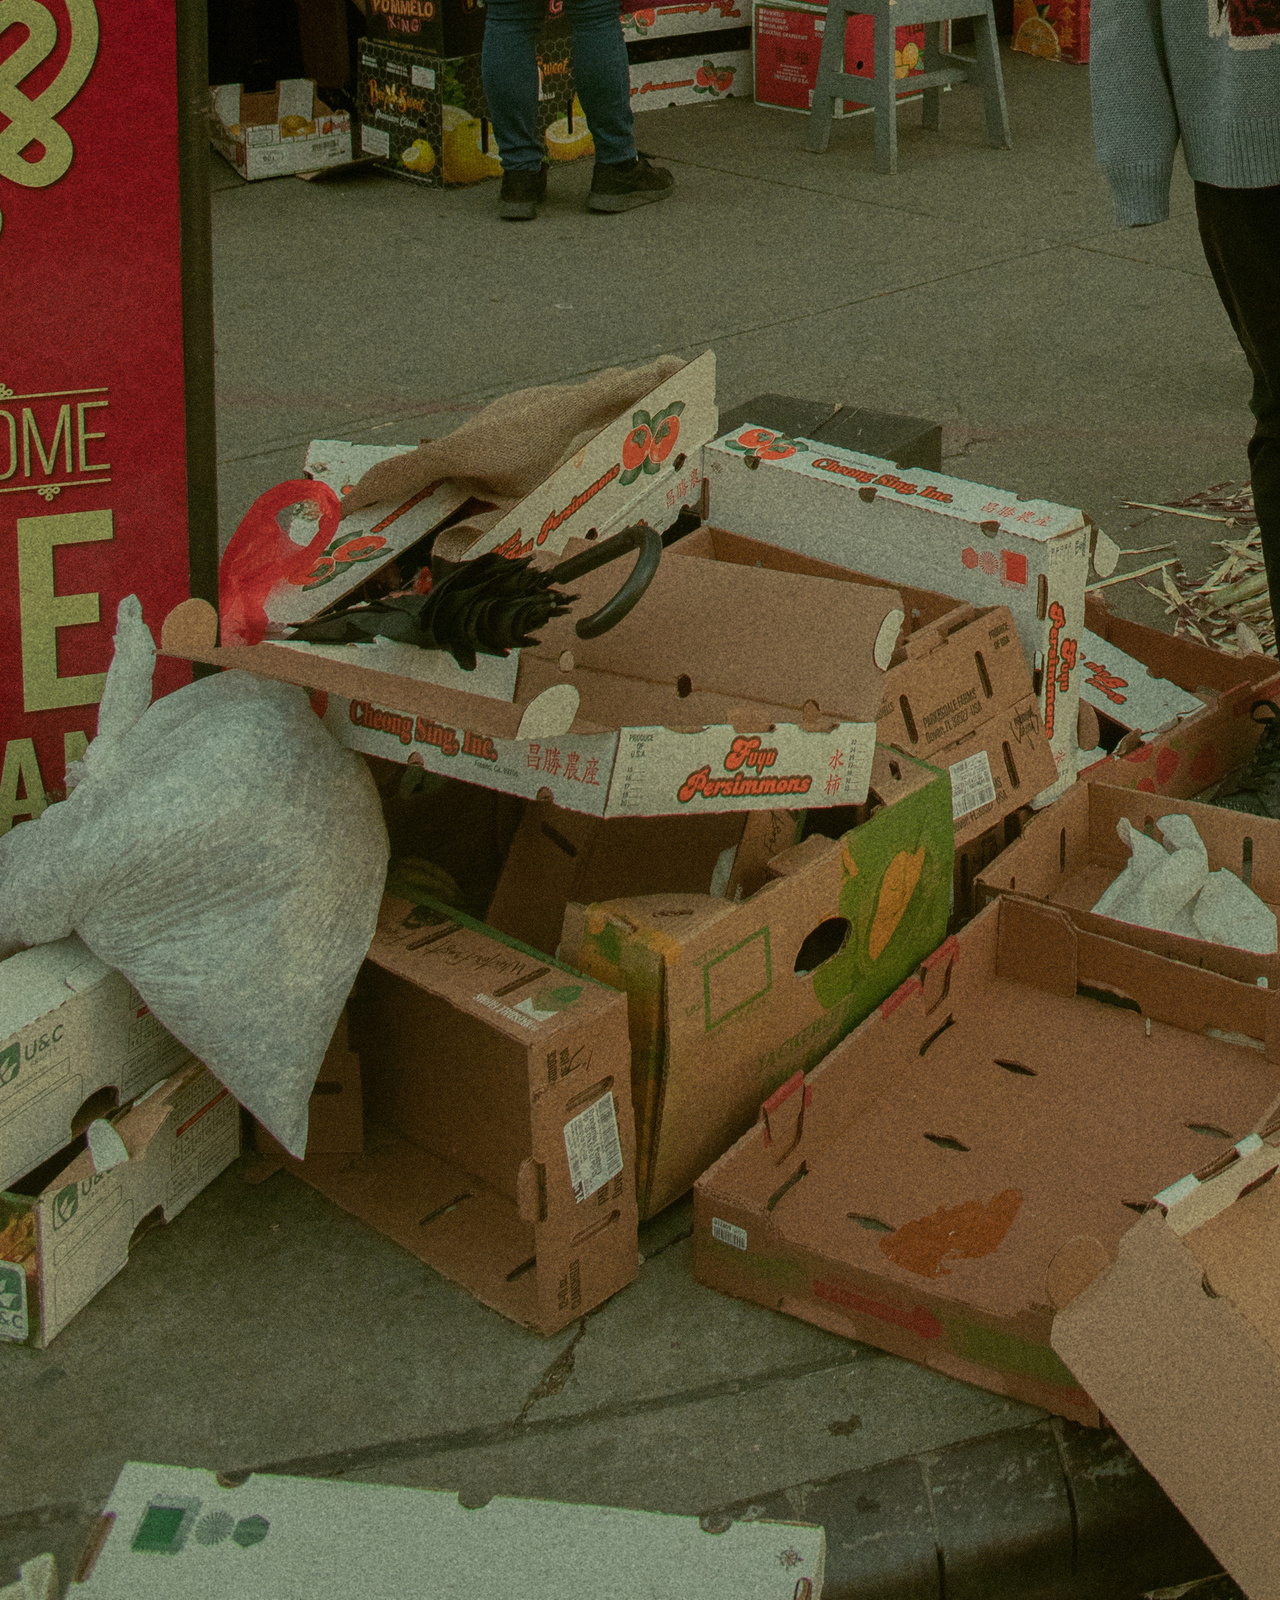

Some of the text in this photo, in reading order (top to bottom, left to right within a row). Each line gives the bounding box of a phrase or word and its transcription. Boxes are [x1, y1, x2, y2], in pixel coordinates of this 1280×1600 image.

[811, 457, 877, 483] Cheong
[349, 699, 414, 745] Cheong
[460, 729, 498, 762] Inc.
[629, 734, 653, 742] PRODUCE
[725, 736, 778, 776] Fuyu
[677, 764, 812, 803] Persimmons
[25, 1023, 64, 1061] U&C
